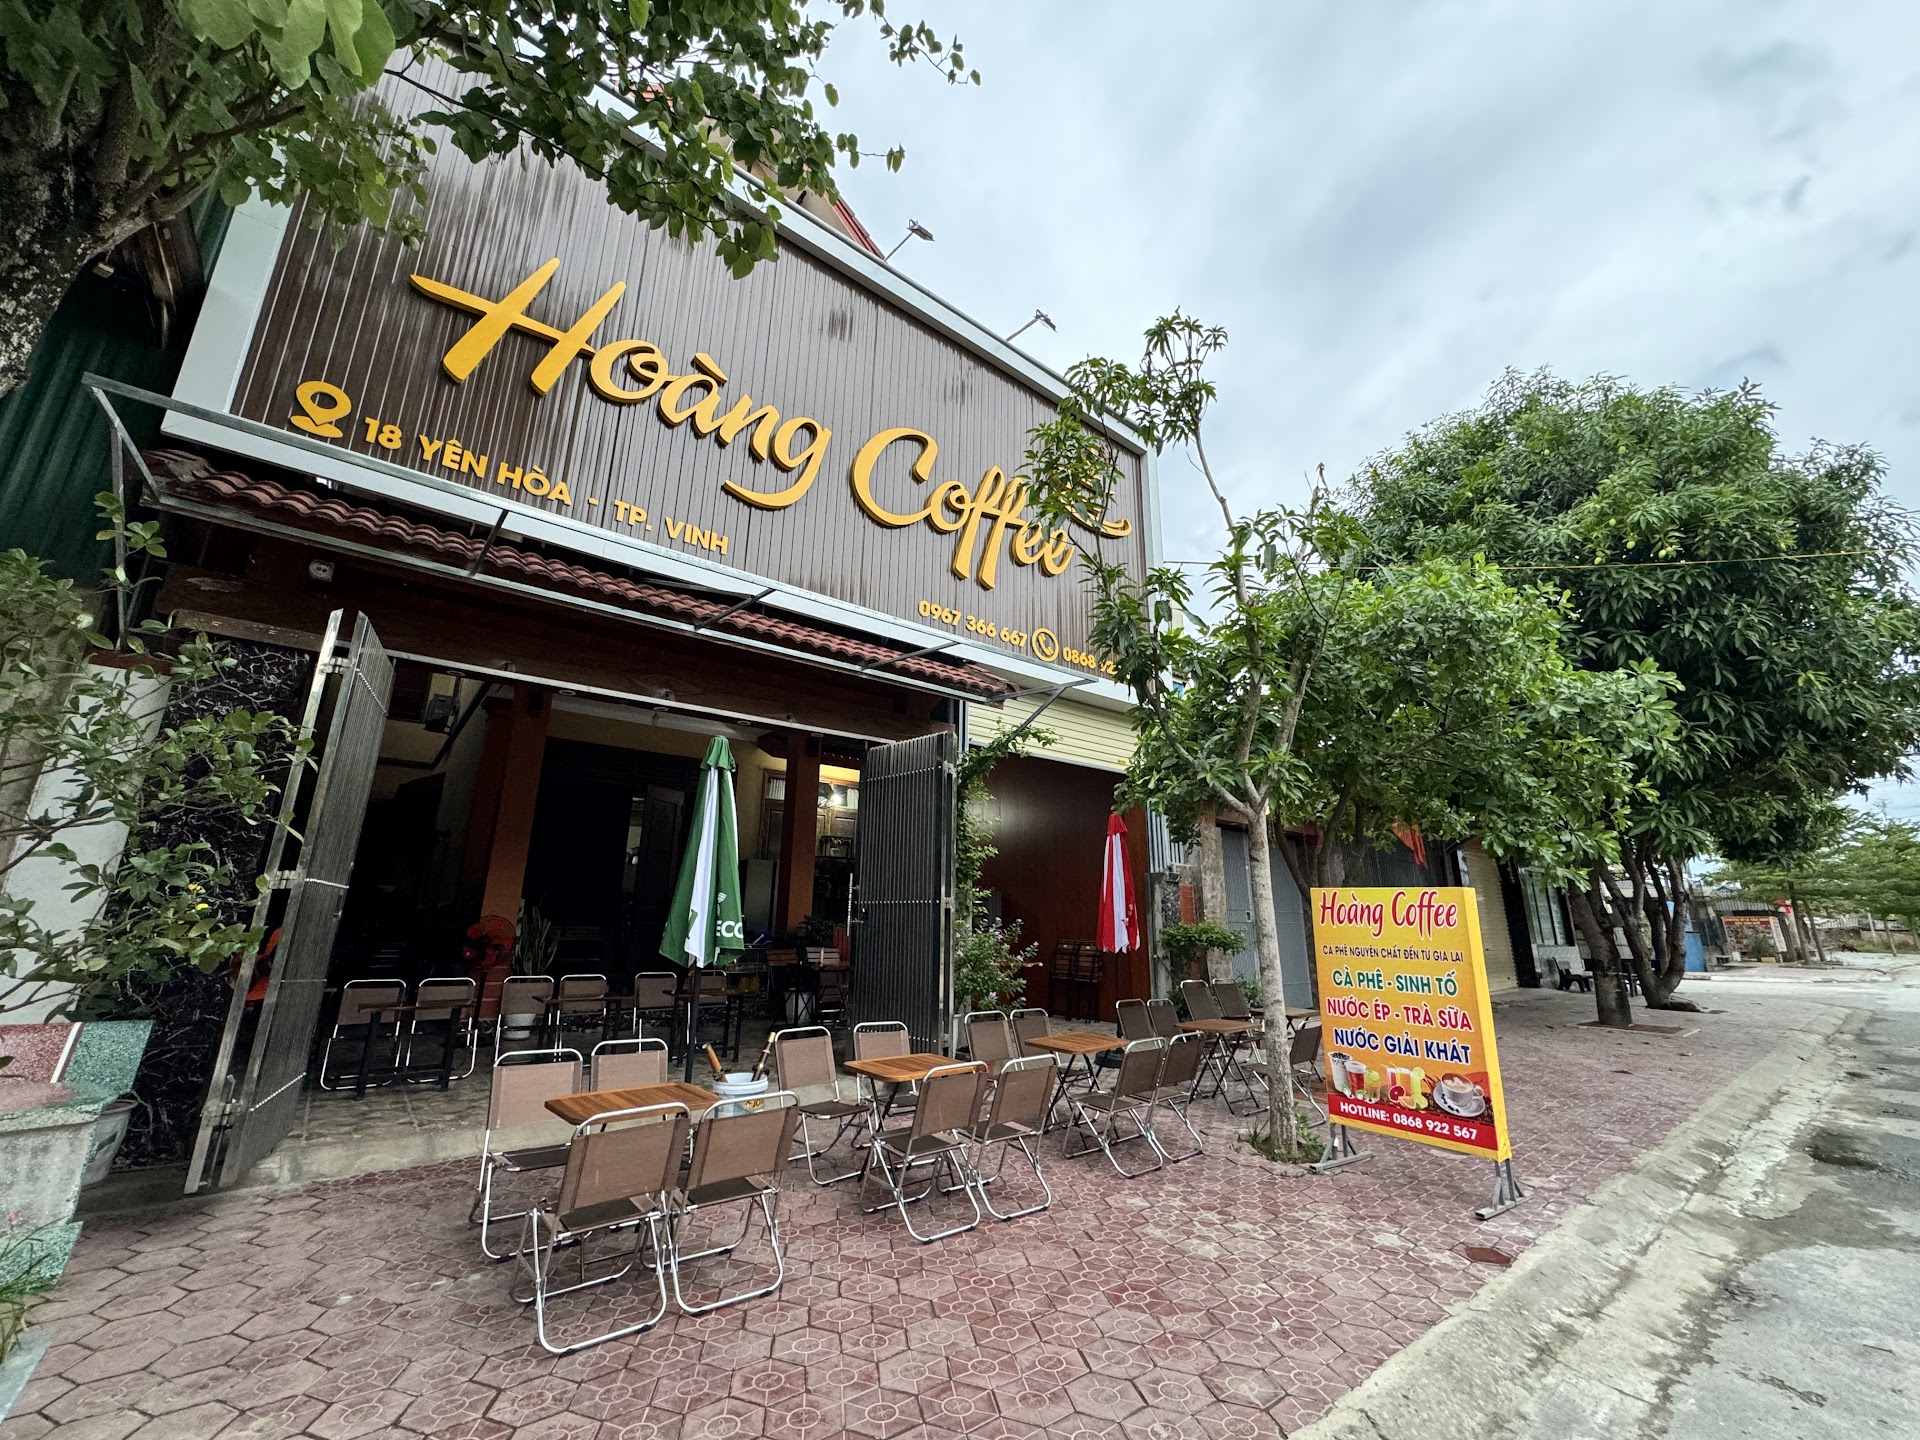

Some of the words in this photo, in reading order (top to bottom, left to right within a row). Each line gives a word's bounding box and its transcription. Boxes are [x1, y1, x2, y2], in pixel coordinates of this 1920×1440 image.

[410, 257, 831, 509] Hoàng
[851, 427, 1076, 590] Coffee
[364, 417, 402, 450] 18
[419, 435, 488, 479] YÊN
[497, 462, 572, 506] HÒA
[614, 500, 652, 531] TP.
[666, 517, 729, 555] VINH
[918, 600, 962, 626] 0967
[966, 615, 997, 638] 366
[1000, 626, 1028, 647] 667
[1063, 647, 1096, 669] 0868
[1320, 891, 1384, 937] Hoàng
[1391, 891, 1457, 939] Coffee
[1323, 943, 1334, 955] CÀ
[1335, 943, 1348, 956] PHÊ
[1350, 945, 1379, 958] NGUYÊN
[1381, 944, 1401, 959] CHẤT
[1404, 946, 1419, 960] ĐẾN
[1433, 951, 1448, 962] GIA
[1451, 952, 1464, 962] LAI
[1332, 966, 1354, 987] CÀ
[1357, 968, 1384, 990] PHÊ
[1396, 974, 1432, 994] SINH
[1435, 970, 1458, 996] TỐ
[1327, 996, 1369, 1018] NƯỚC
[1374, 998, 1391, 1020] ÉP
[1403, 1003, 1434, 1026] TRÀ
[1438, 1006, 1473, 1031] SỮA
[1334, 1027, 1379, 1050] NƯỚC
[1384, 1031, 1419, 1056] GIẢI
[1425, 1038, 1470, 1064] KHÁT
[1340, 1101, 1390, 1122] HOTLINE:
[1393, 1112, 1423, 1129] 0868
[1425, 1120, 1450, 1134] 922
[1453, 1125, 1477, 1140] 567
